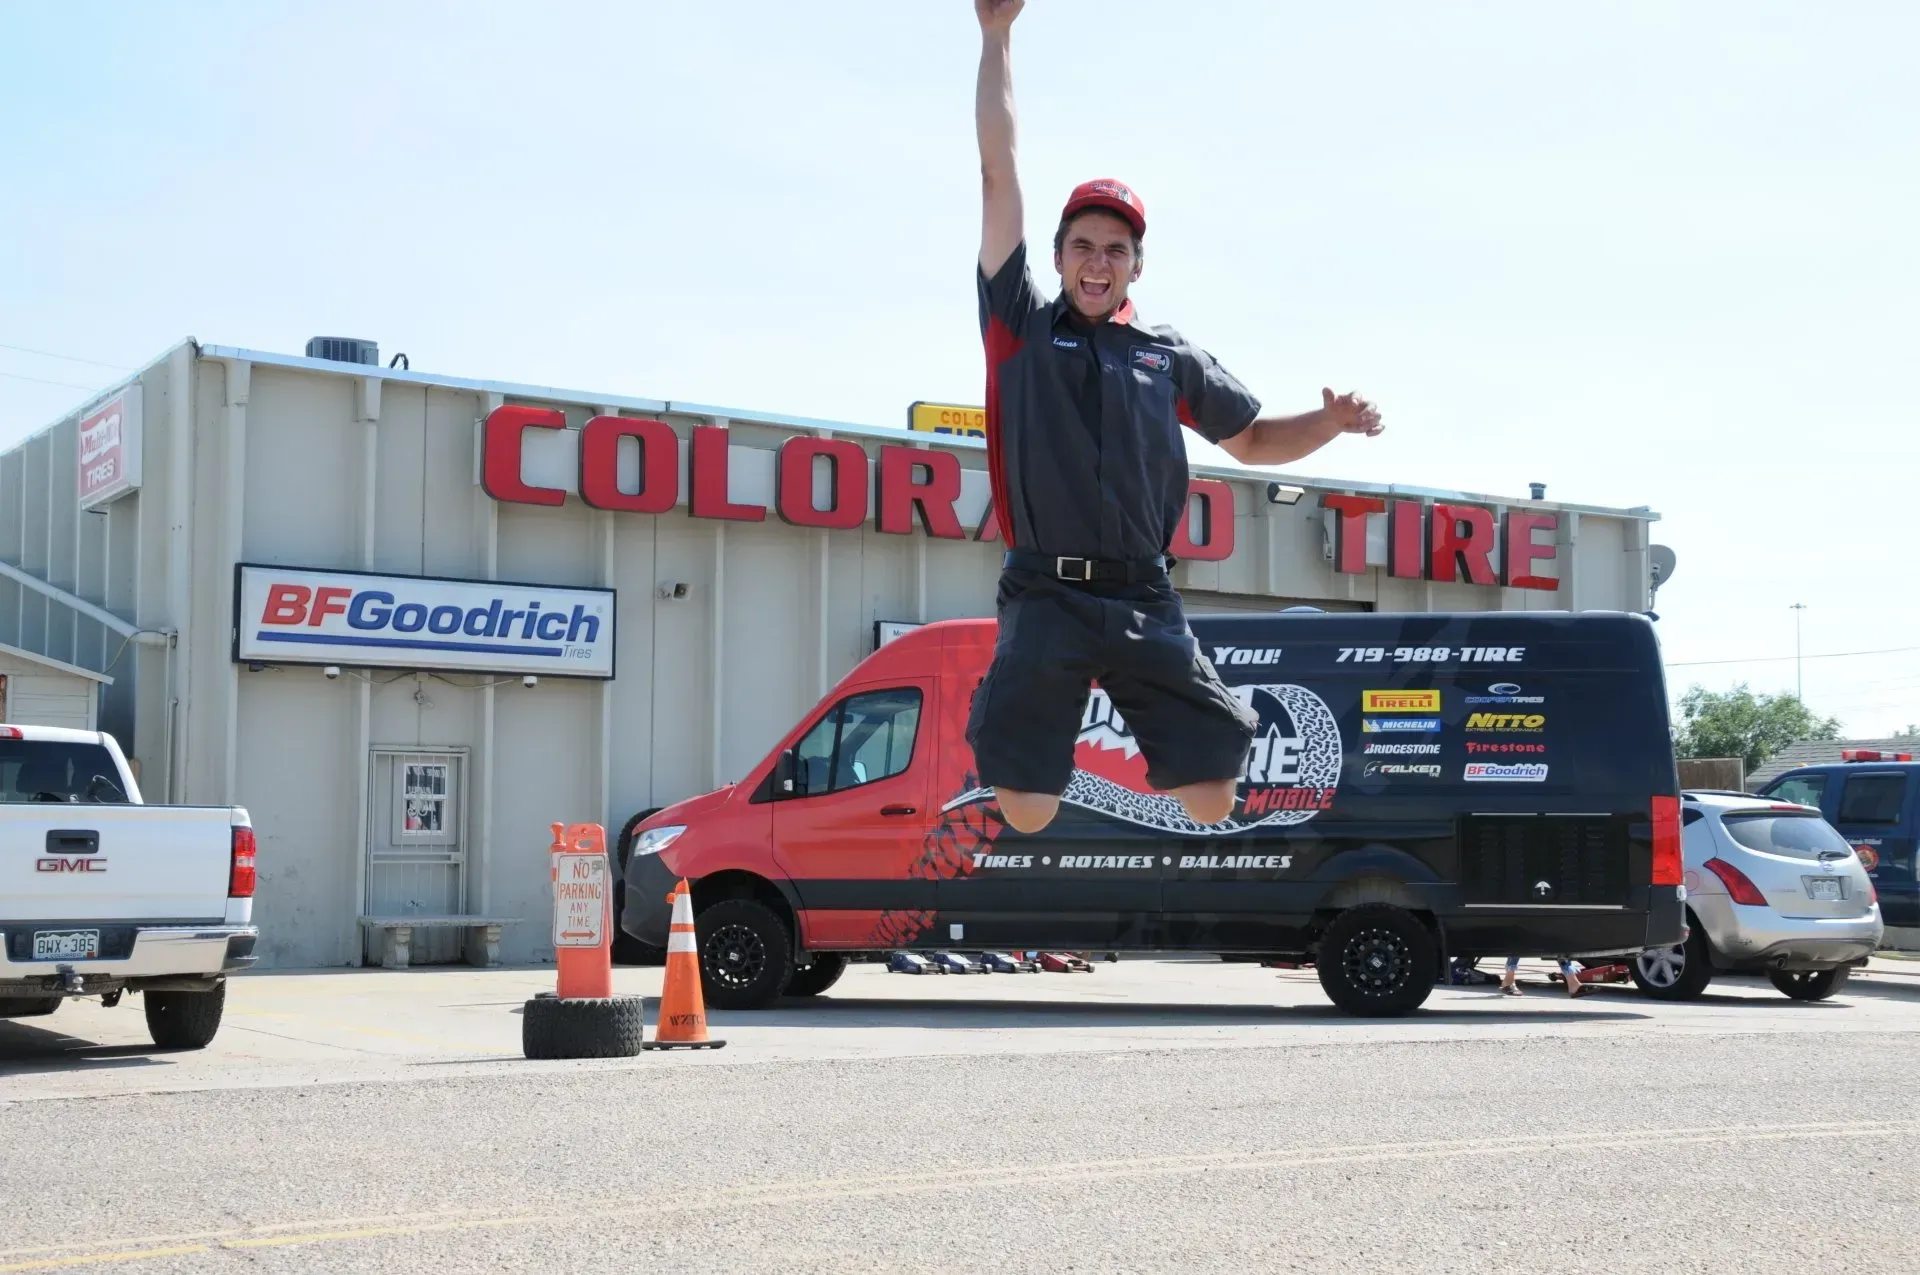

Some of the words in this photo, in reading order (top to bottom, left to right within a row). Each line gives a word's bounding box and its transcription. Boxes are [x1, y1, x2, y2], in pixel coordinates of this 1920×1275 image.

[941, 410, 984, 427] COLO
[86, 457, 115, 488] TIRES
[480, 403, 1235, 561] COLORO
[1317, 493, 1561, 591] TIRE
[261, 583, 602, 643] BFGoodrich
[562, 644, 593, 660] Tires
[1335, 646, 1526, 663] 719-988-TIRE
[1370, 694, 1433, 708] PIRELLI
[1382, 720, 1437, 729] MICHELIN
[1465, 712, 1546, 728] NITTO
[1364, 743, 1441, 754] BRIDGESTONE
[1465, 741, 1546, 754] Firestone
[1380, 764, 1442, 773] FALKEN
[1467, 765, 1546, 776] BFGoodrich
[1243, 788, 1337, 815] MOBILE
[35, 858, 108, 872] GMC
[1059, 855, 1155, 869] ROTATES
[1179, 855, 1293, 869] BALANCES
[573, 862, 590, 879] NO
[560, 883, 601, 900] PARKING
[570, 901, 589, 914] ANY
[567, 915, 590, 928] TIME
